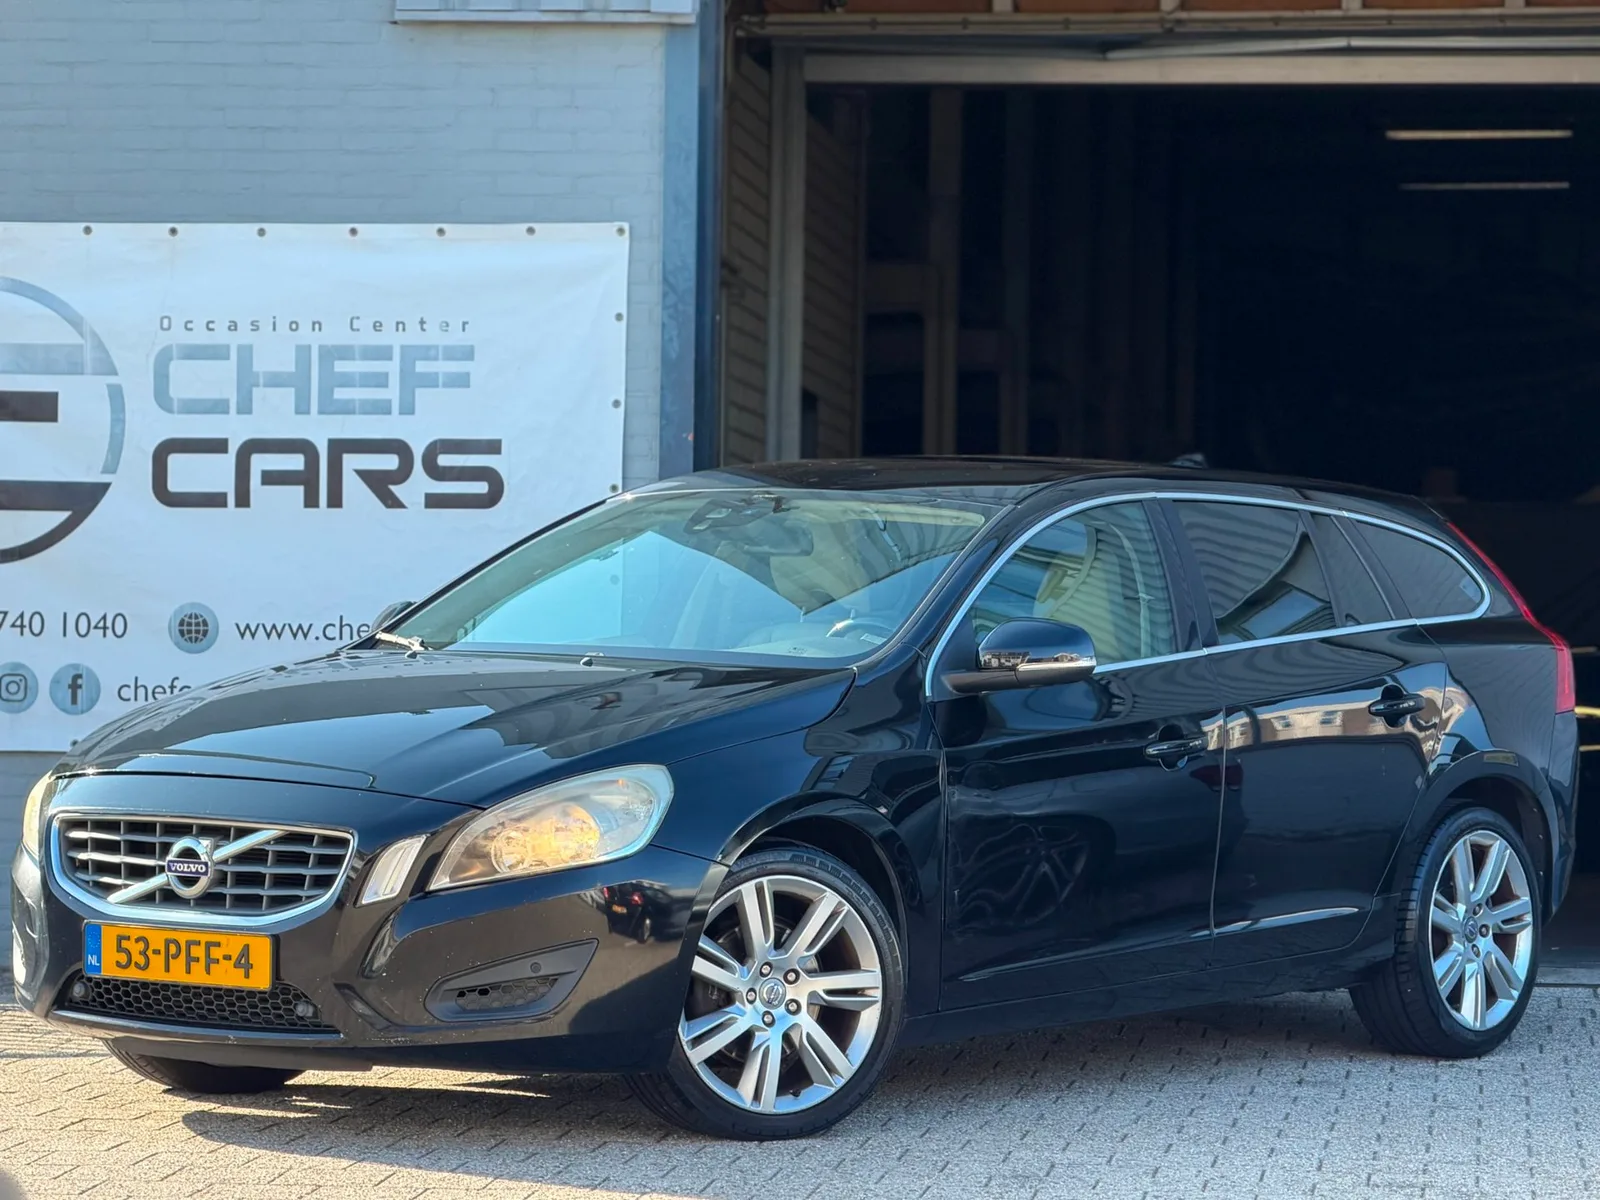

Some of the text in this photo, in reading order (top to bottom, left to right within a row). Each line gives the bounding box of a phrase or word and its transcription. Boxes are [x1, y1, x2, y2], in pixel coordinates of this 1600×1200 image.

[159, 315, 470, 333] Occasion Center
[153, 343, 475, 416] CHEF
[152, 437, 505, 509] CARS
[62, 611, 128, 639] 1040
[168, 861, 207, 873] VOLVO
[87, 954, 100, 967] NL
[115, 934, 253, 979] 53-PFF-4
